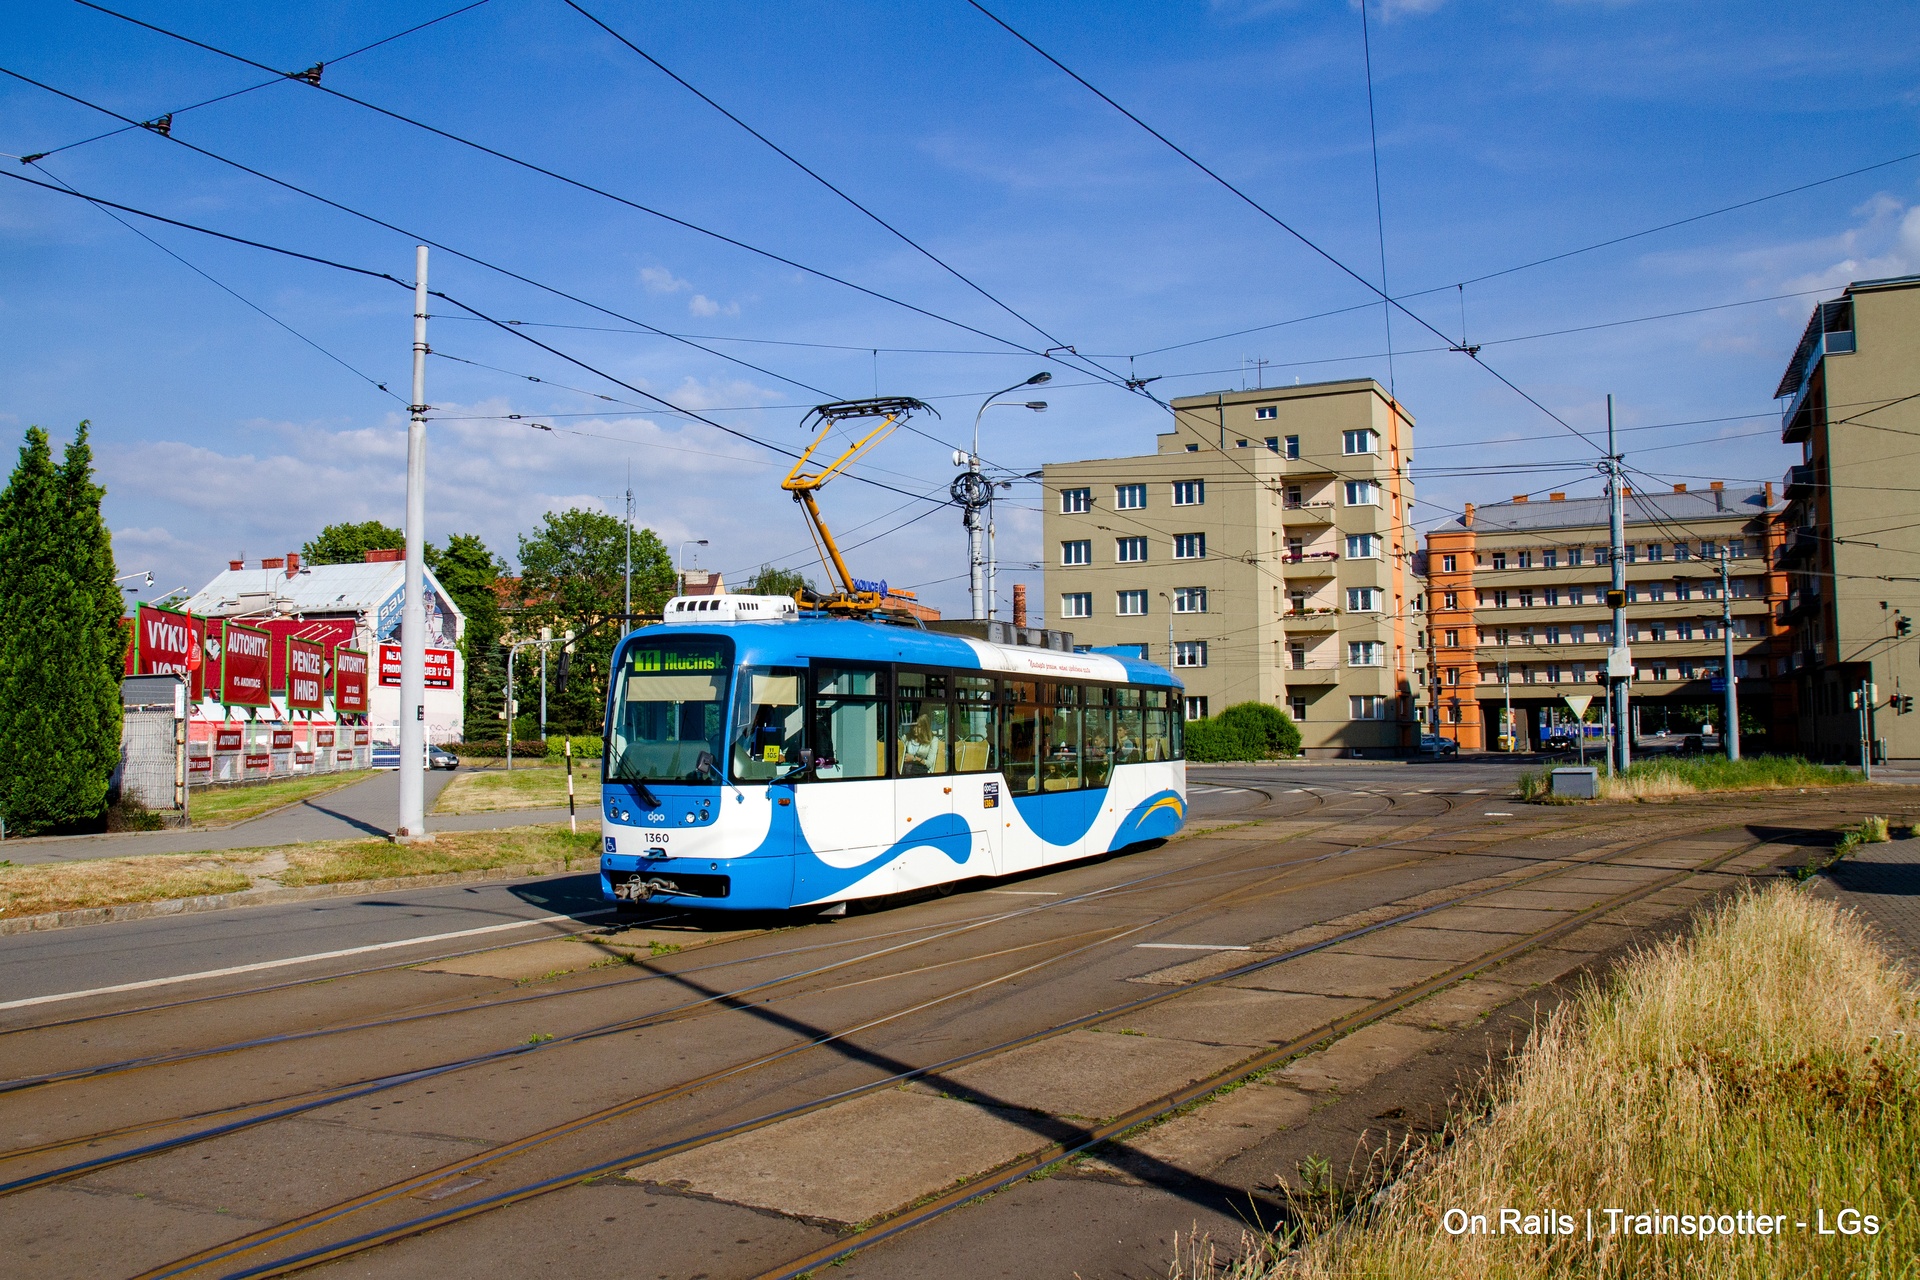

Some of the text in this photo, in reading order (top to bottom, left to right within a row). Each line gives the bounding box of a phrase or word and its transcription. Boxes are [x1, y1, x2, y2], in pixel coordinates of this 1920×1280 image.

[292, 648, 321, 675] PENÍZE
[443, 664, 452, 677] ČR
[294, 678, 318, 702] IHNED
[219, 735, 240, 746] AUTOHITY
[644, 833, 670, 843] 1360
